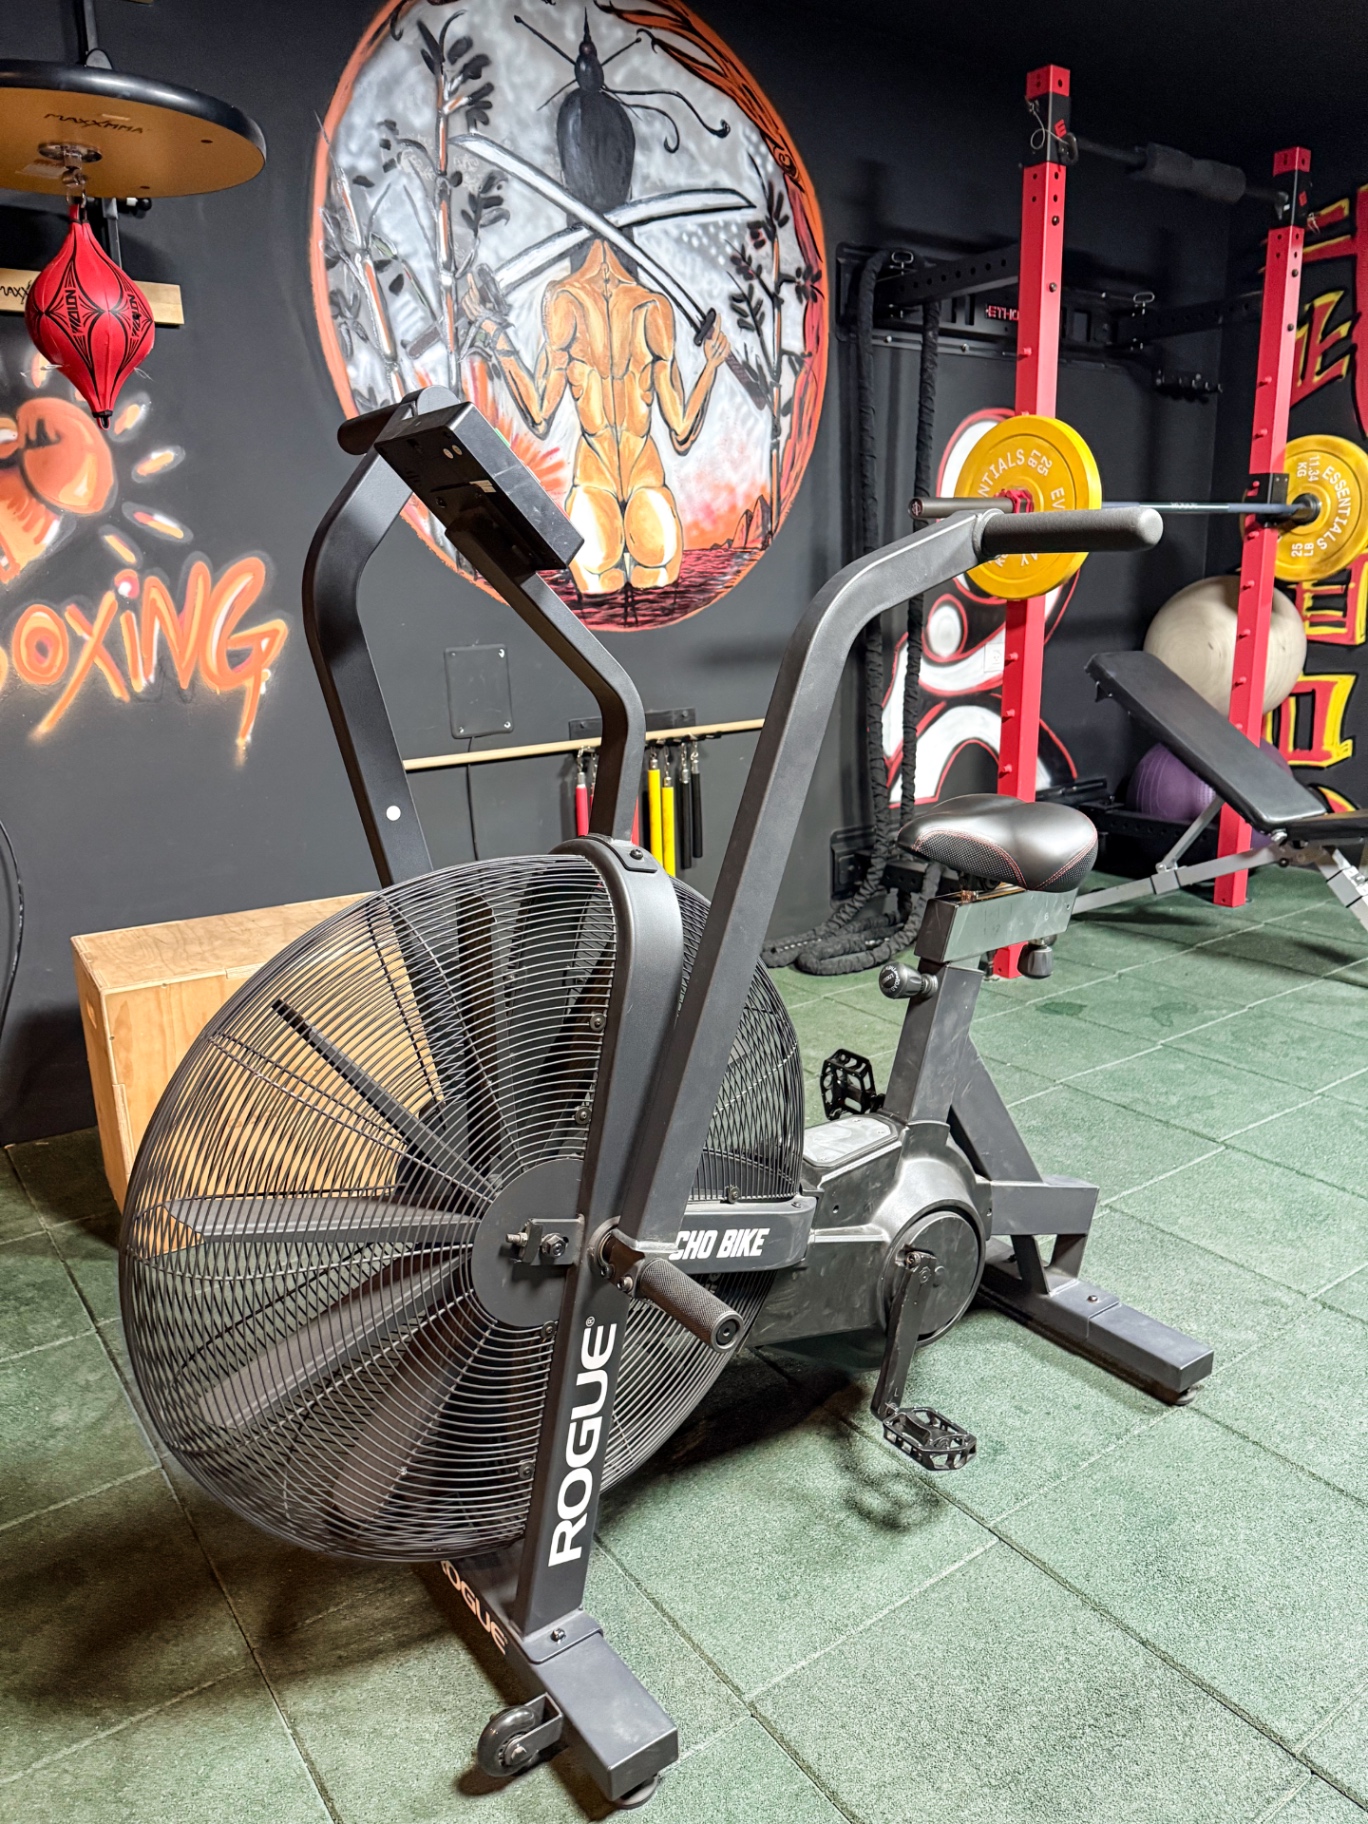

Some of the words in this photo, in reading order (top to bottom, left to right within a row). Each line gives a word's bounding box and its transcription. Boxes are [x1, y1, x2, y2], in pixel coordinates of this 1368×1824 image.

[987, 305, 1019, 321] ETHO
[1027, 449, 1042, 468] LB
[1037, 456, 1053, 477] 25
[1308, 455, 1321, 482] 11.34
[977, 448, 1025, 498] NTIALS
[1296, 461, 1308, 478] KG
[1316, 465, 1352, 550] ESSENTIALS
[1291, 542, 1303, 557] 25
[1303, 542, 1315, 557] LB
[0, 556, 289, 746] OXiNG
[668, 1229, 718, 1261] CHO
[716, 1227, 770, 1259] BIKE
